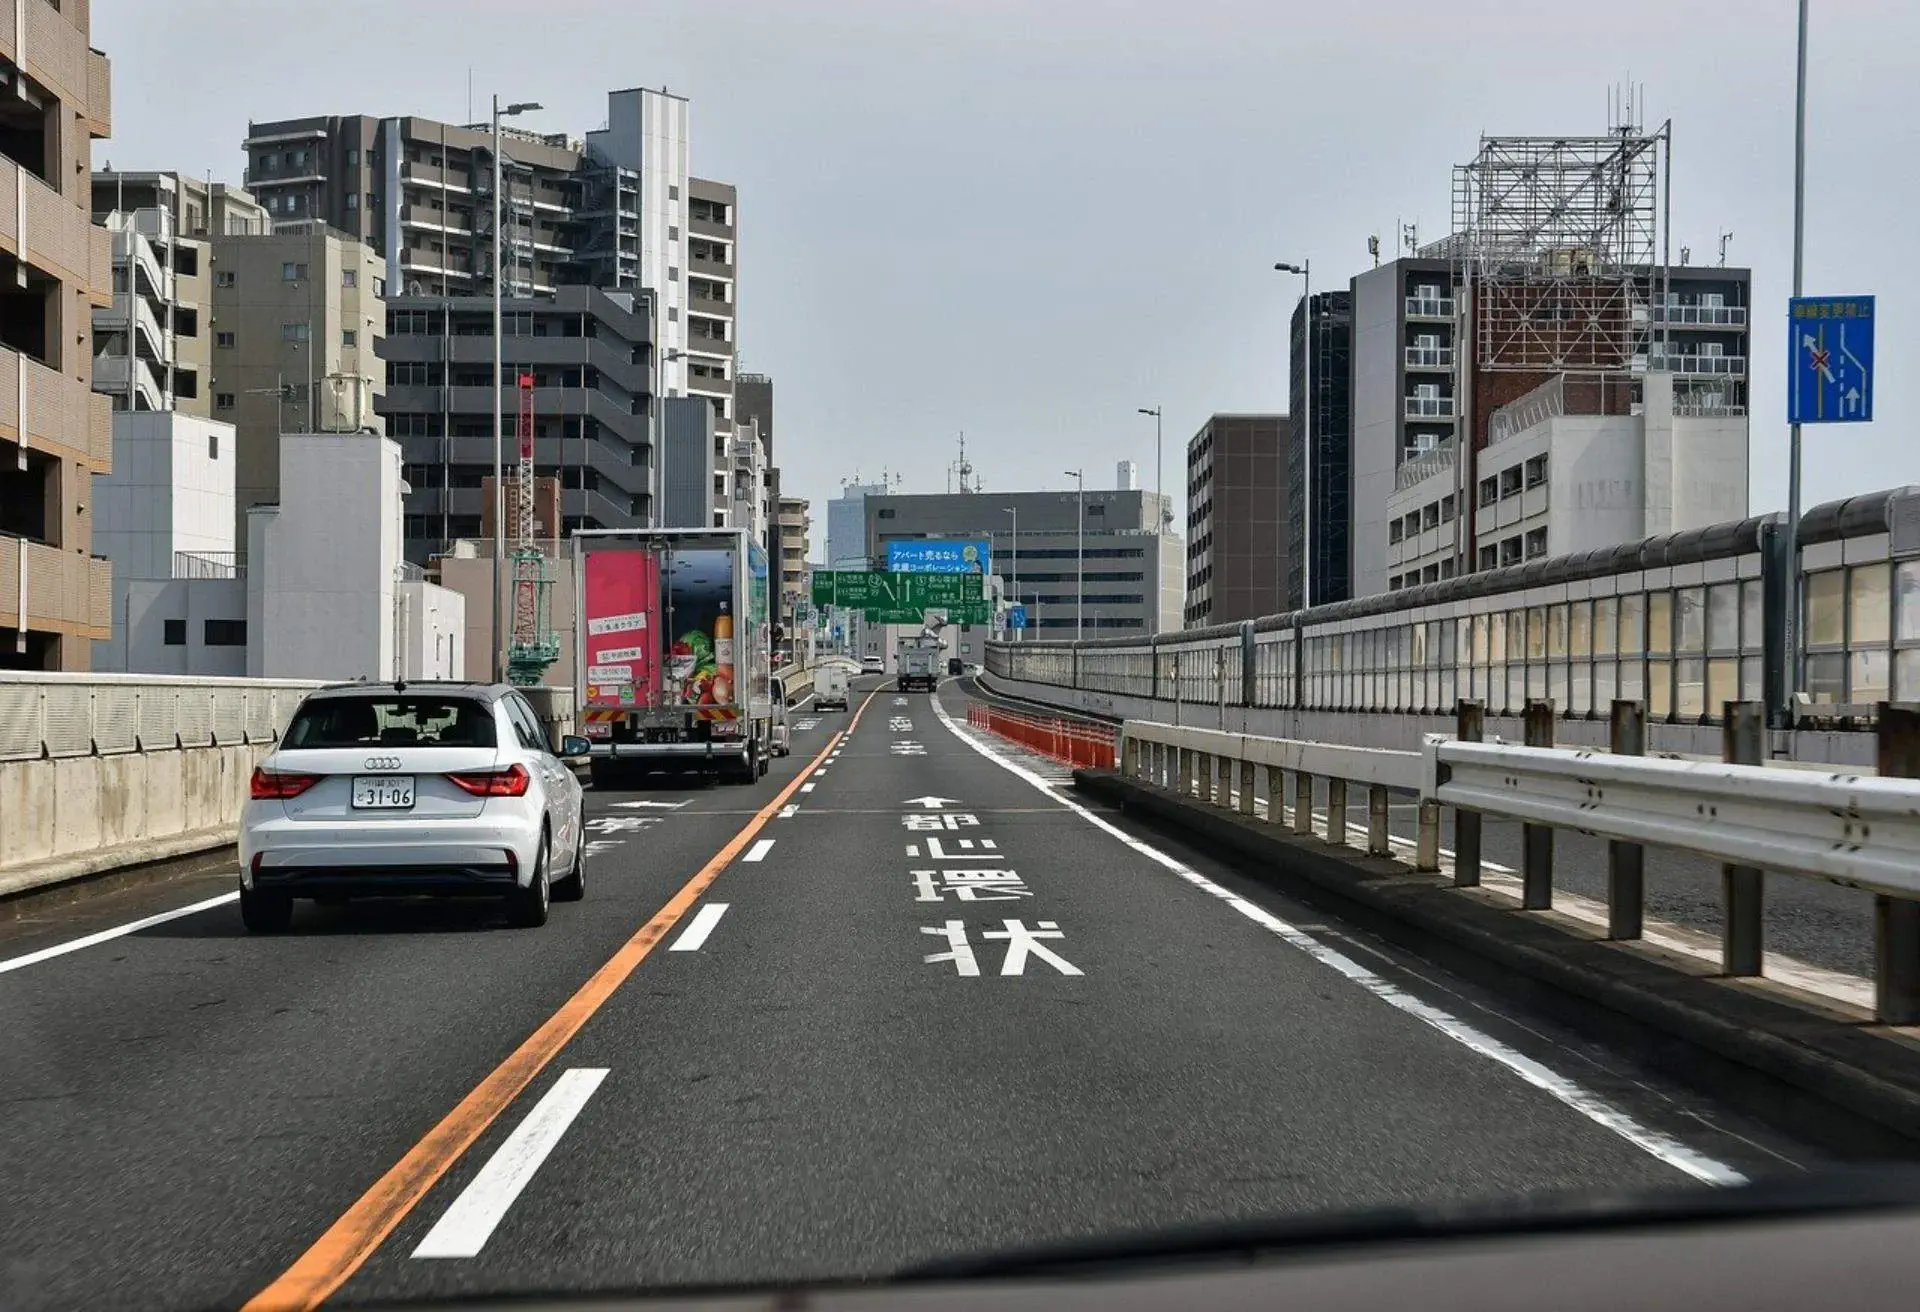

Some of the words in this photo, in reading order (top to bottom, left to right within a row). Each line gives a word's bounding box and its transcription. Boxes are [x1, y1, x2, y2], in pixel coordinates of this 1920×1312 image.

[893, 550, 958, 561] アパート売るなら
[367, 789, 410, 804] 31-06
